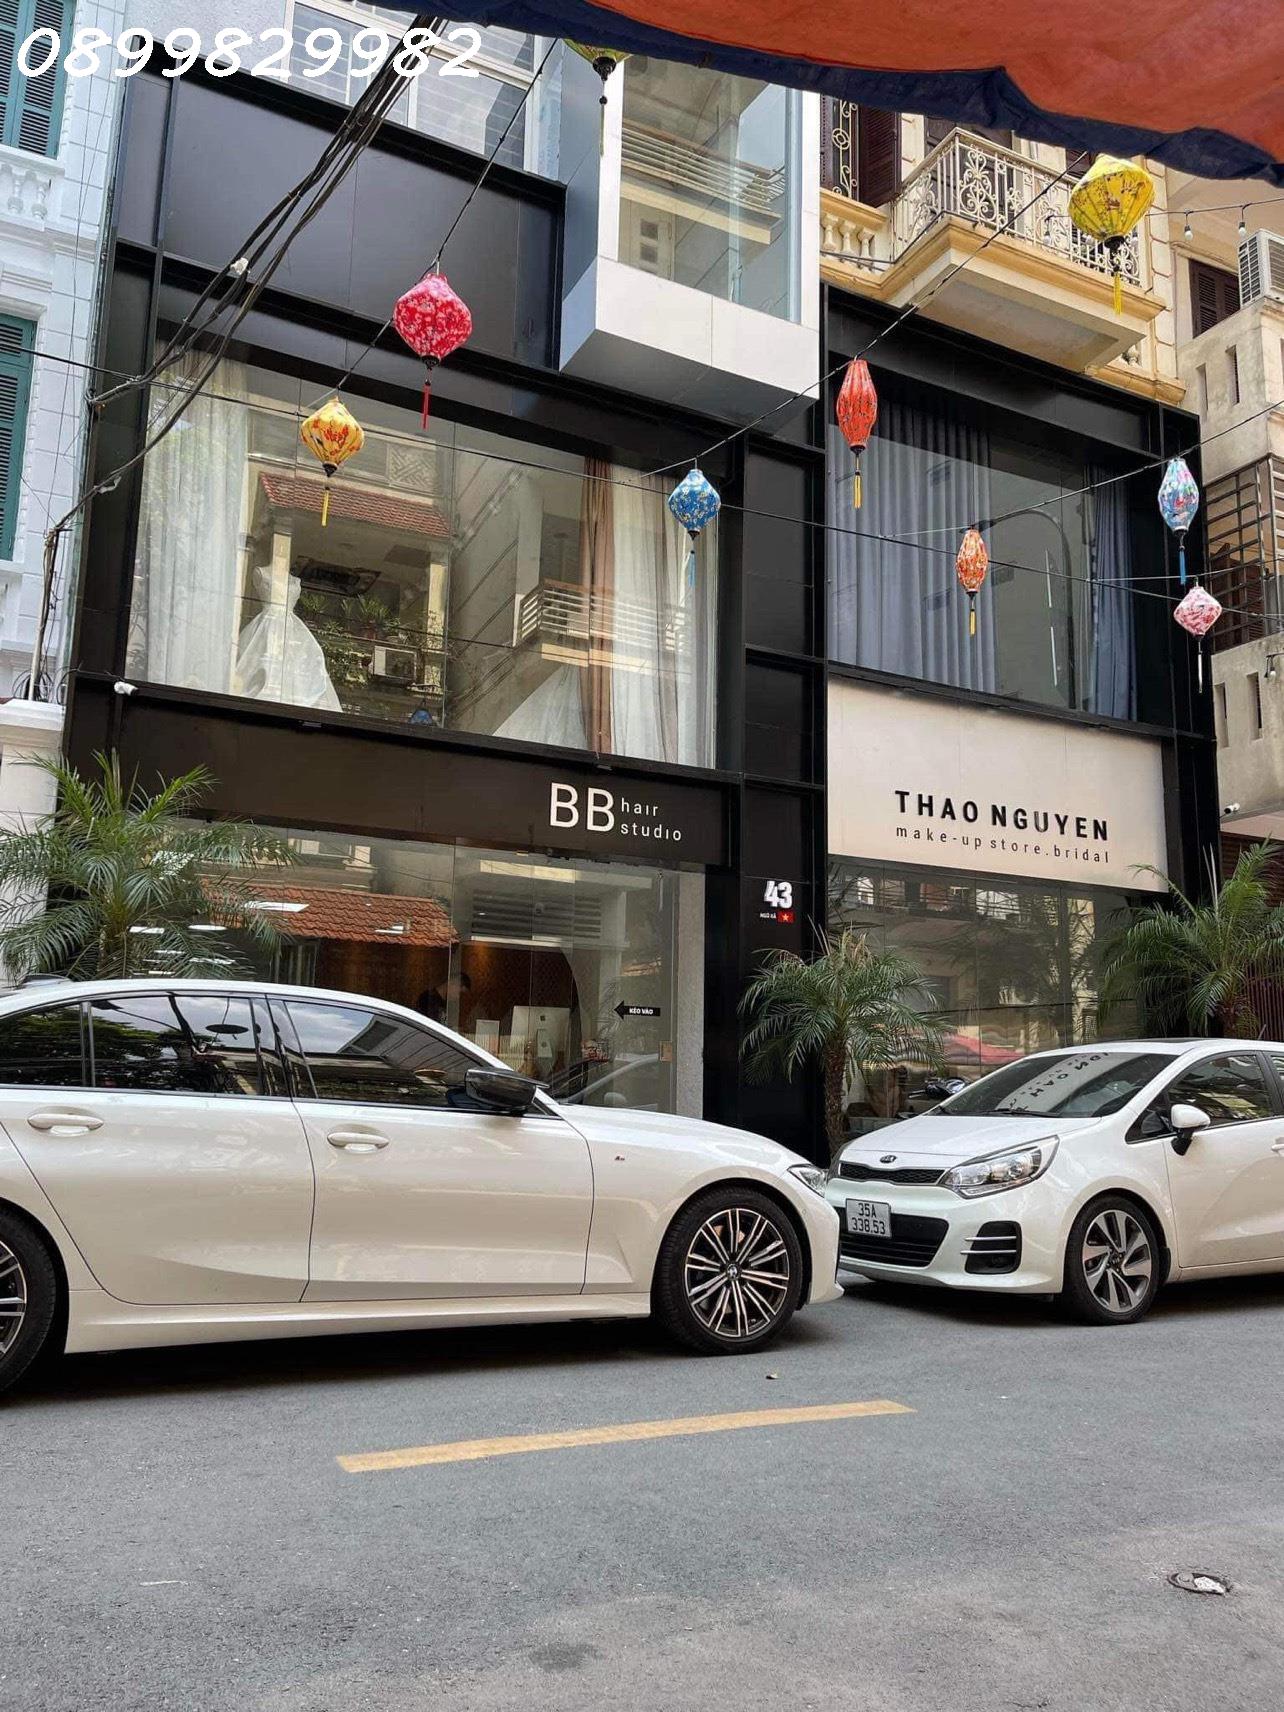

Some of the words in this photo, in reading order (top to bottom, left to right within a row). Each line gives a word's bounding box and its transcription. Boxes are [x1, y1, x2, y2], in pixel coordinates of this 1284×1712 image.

[549, 782, 615, 832] BB
[621, 797, 659, 817] hair
[894, 790, 979, 823] THAO
[991, 804, 1108, 841] NGUYEN
[620, 823, 682, 841] studio
[896, 825, 982, 850] make-up
[990, 838, 1109, 863] store.bridal
[763, 880, 793, 909] 43
[858, 1202, 877, 1218] 35A
[851, 1217, 886, 1235] 338.53
